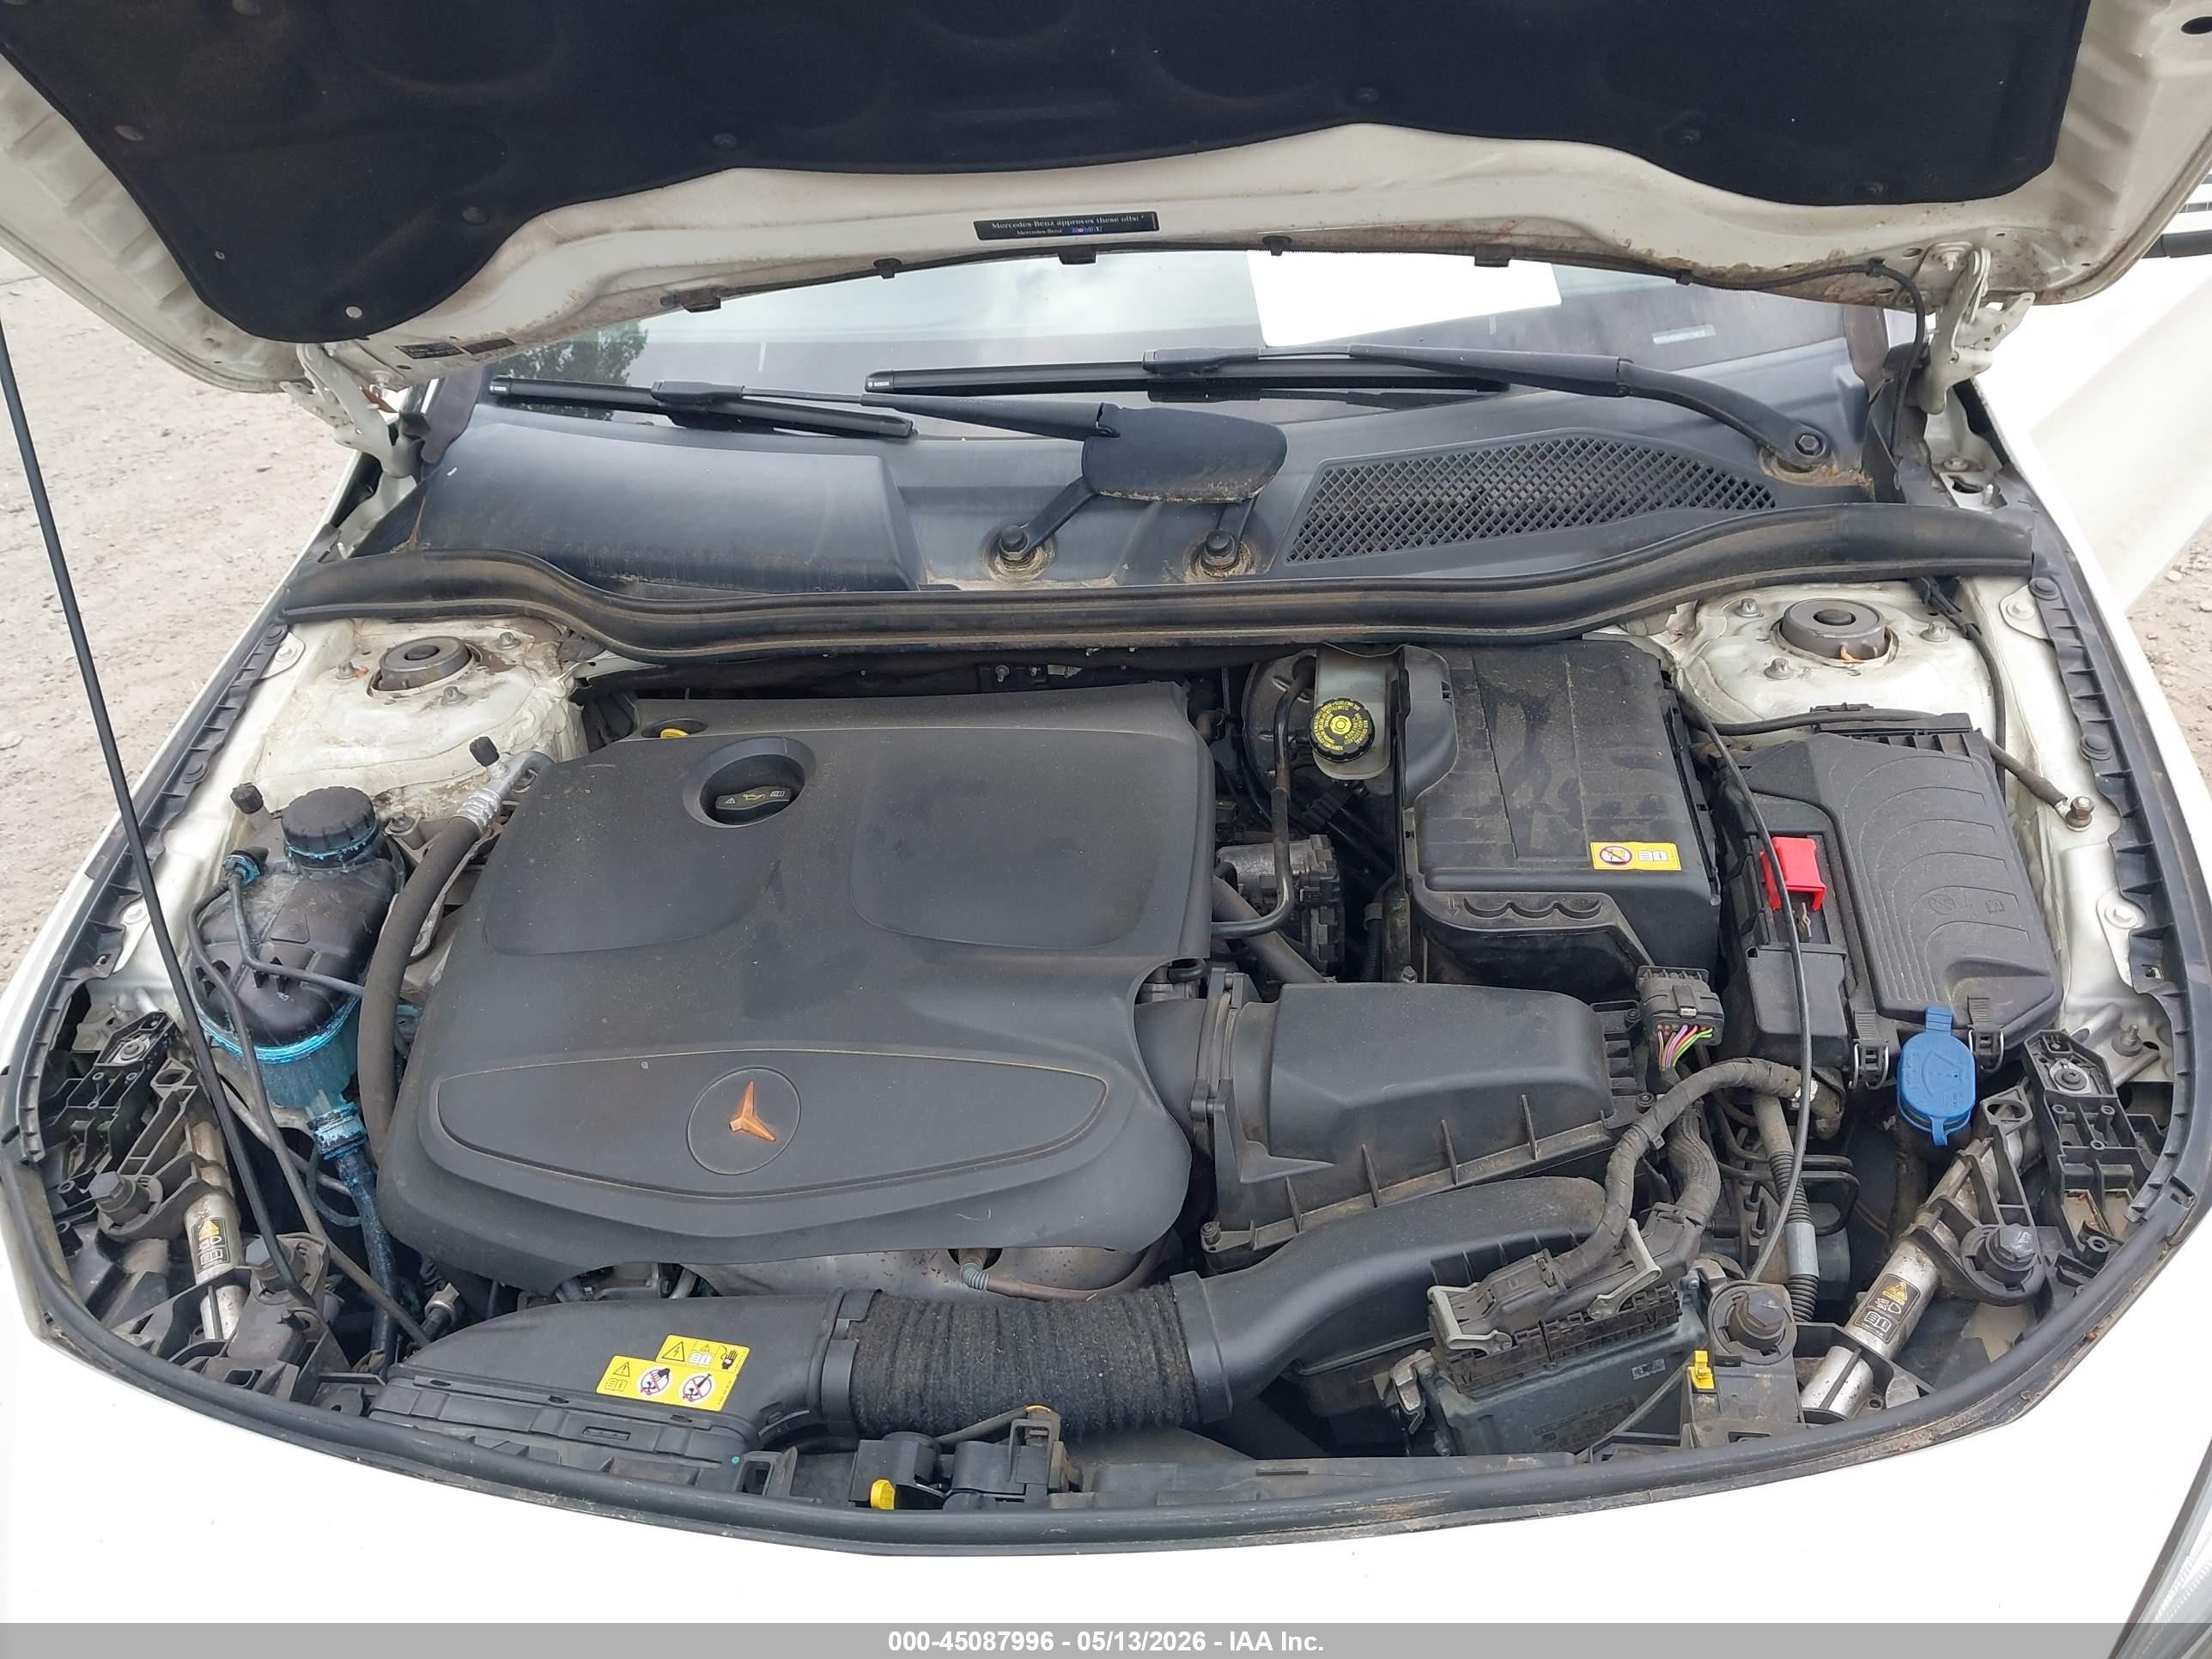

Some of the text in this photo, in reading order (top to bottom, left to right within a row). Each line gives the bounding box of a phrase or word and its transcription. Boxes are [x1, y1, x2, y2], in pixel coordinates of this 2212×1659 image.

[992, 219, 1054, 229] Mercedes-Benz
[1056, 218, 1095, 228] approves
[1017, 228, 1062, 236] Mercedes-Benz
